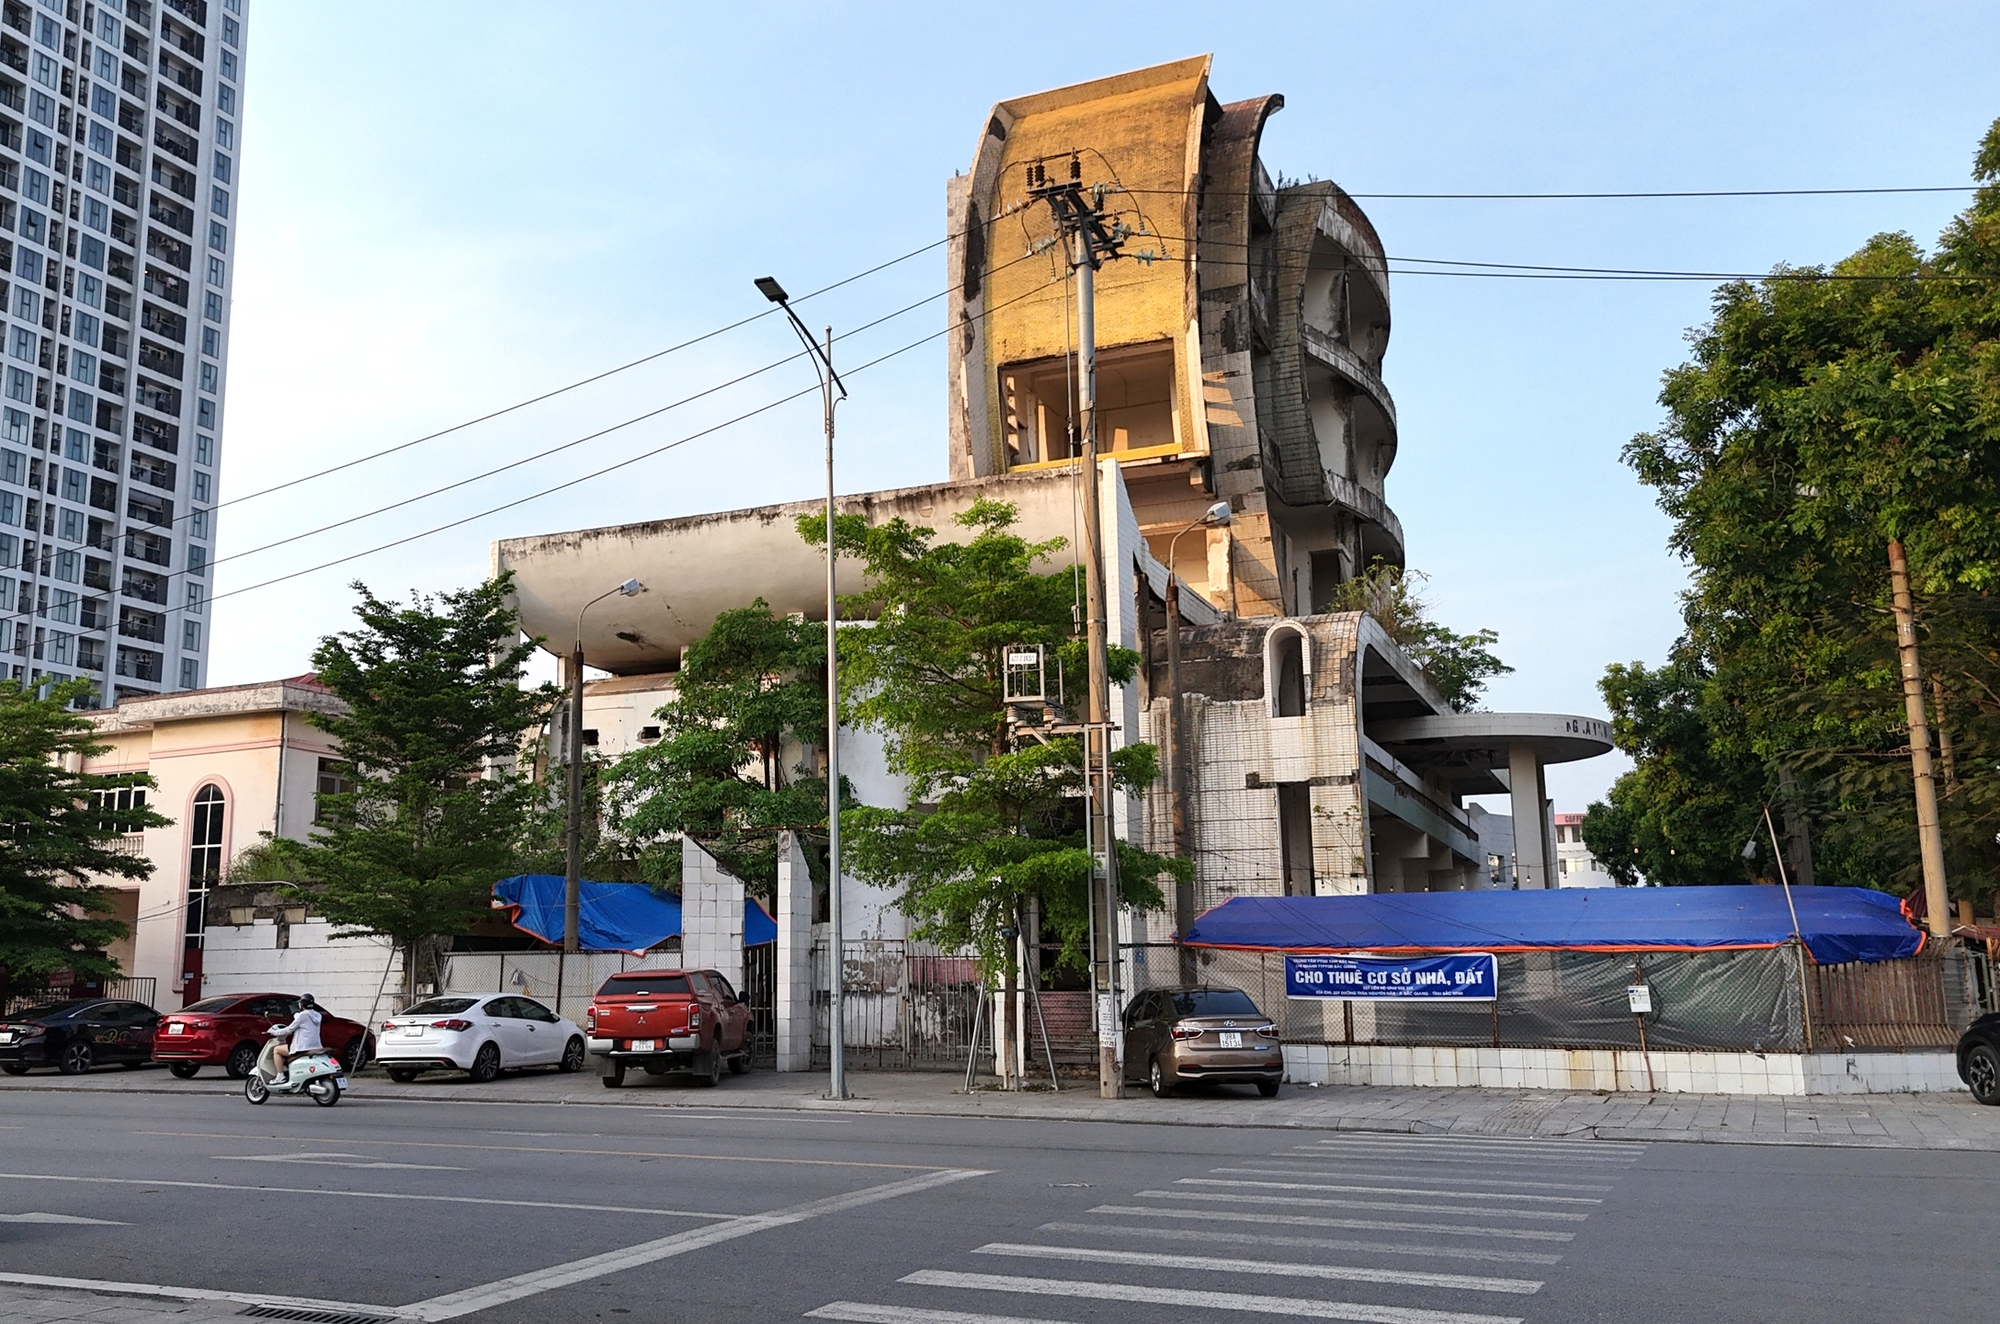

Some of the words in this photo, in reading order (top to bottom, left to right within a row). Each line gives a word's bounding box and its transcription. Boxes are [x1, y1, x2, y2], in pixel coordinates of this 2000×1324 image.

[1295, 970, 1323, 984] CHO
[1327, 969, 1364, 984] THUÊ
[1367, 970, 1388, 985] CƠ
[1391, 967, 1412, 985] SỞ
[1415, 969, 1451, 986] NHÀ,
[1455, 966, 1484, 984] ĐẤT
